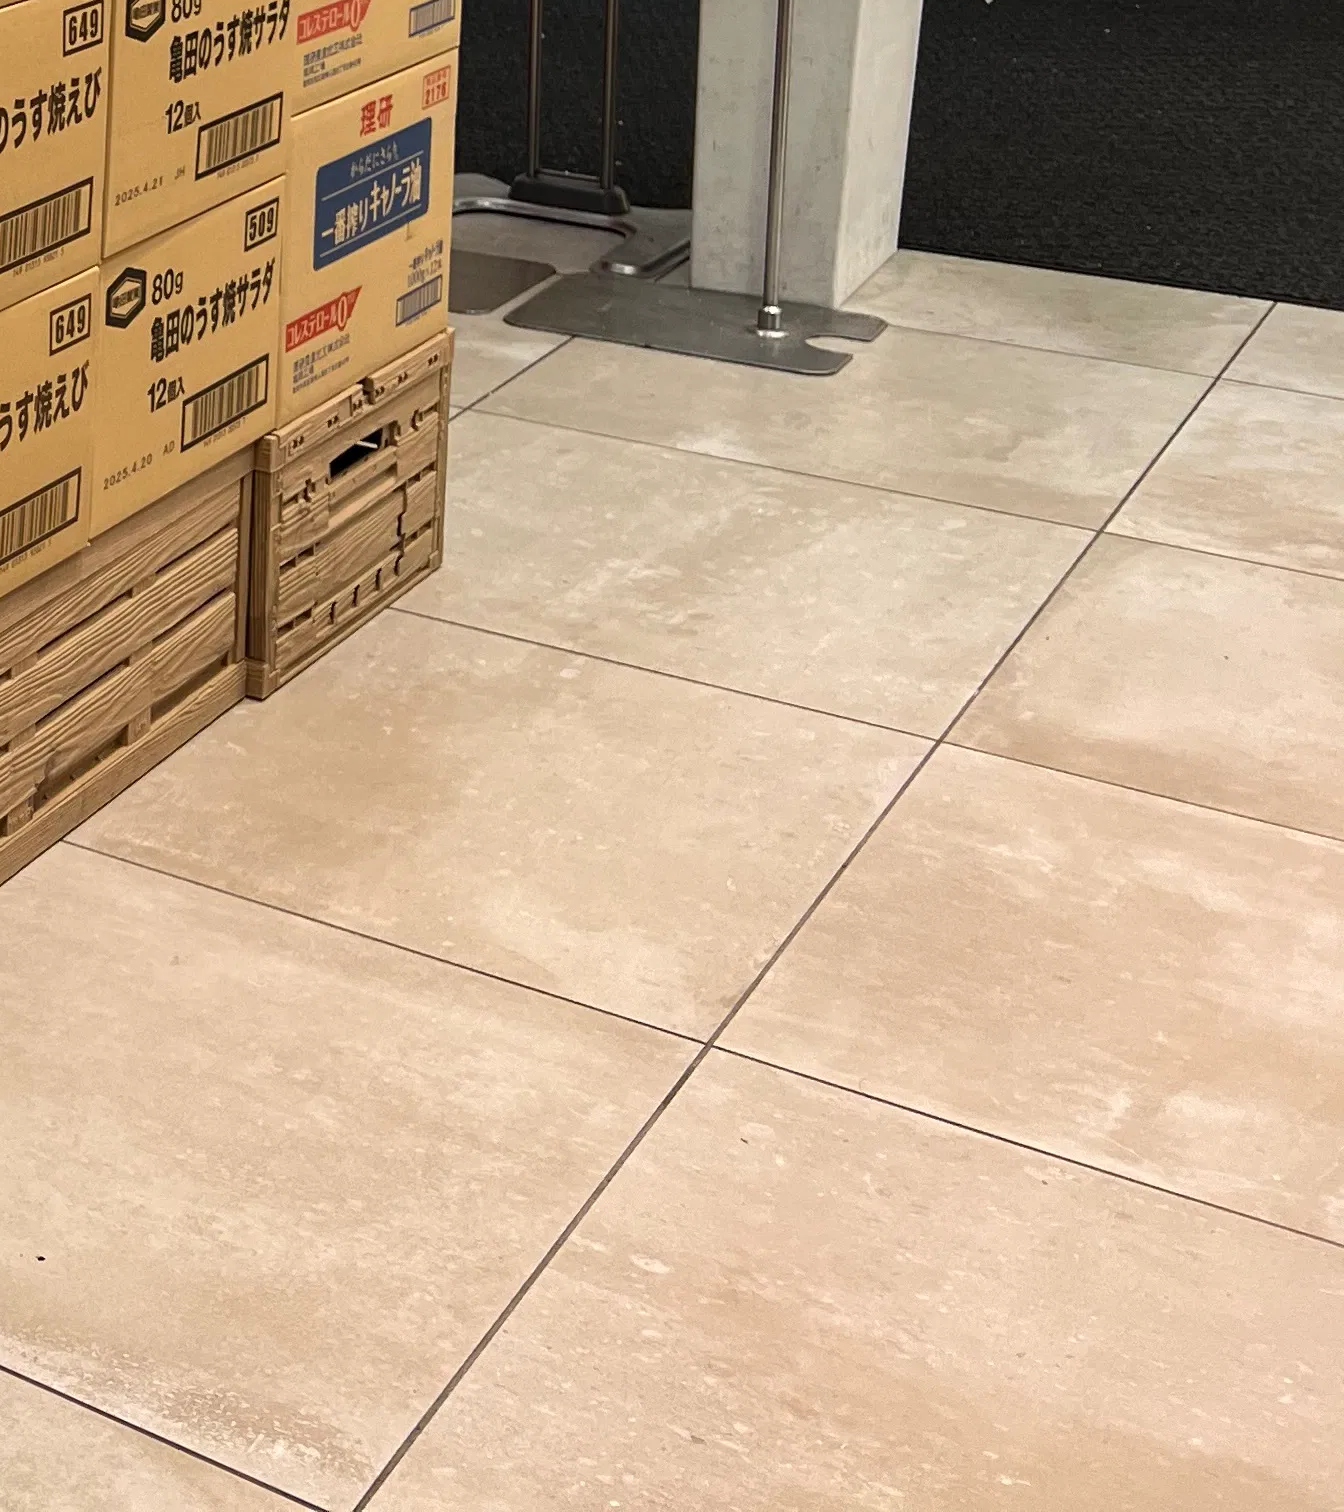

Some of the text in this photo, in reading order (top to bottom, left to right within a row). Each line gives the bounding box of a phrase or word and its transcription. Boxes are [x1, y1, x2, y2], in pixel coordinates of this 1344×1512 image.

[67, 9, 99, 45] 649
[165, 100, 202, 134] 12個入
[360, 95, 393, 136] 理研
[249, 206, 274, 243] 509
[151, 269, 184, 305] 80g
[55, 303, 86, 345] 649
[150, 258, 276, 363] 亀田のうす焼サラダ
[147, 376, 186, 413] 12個入
[103, 455, 154, 490] 2025.4.20
